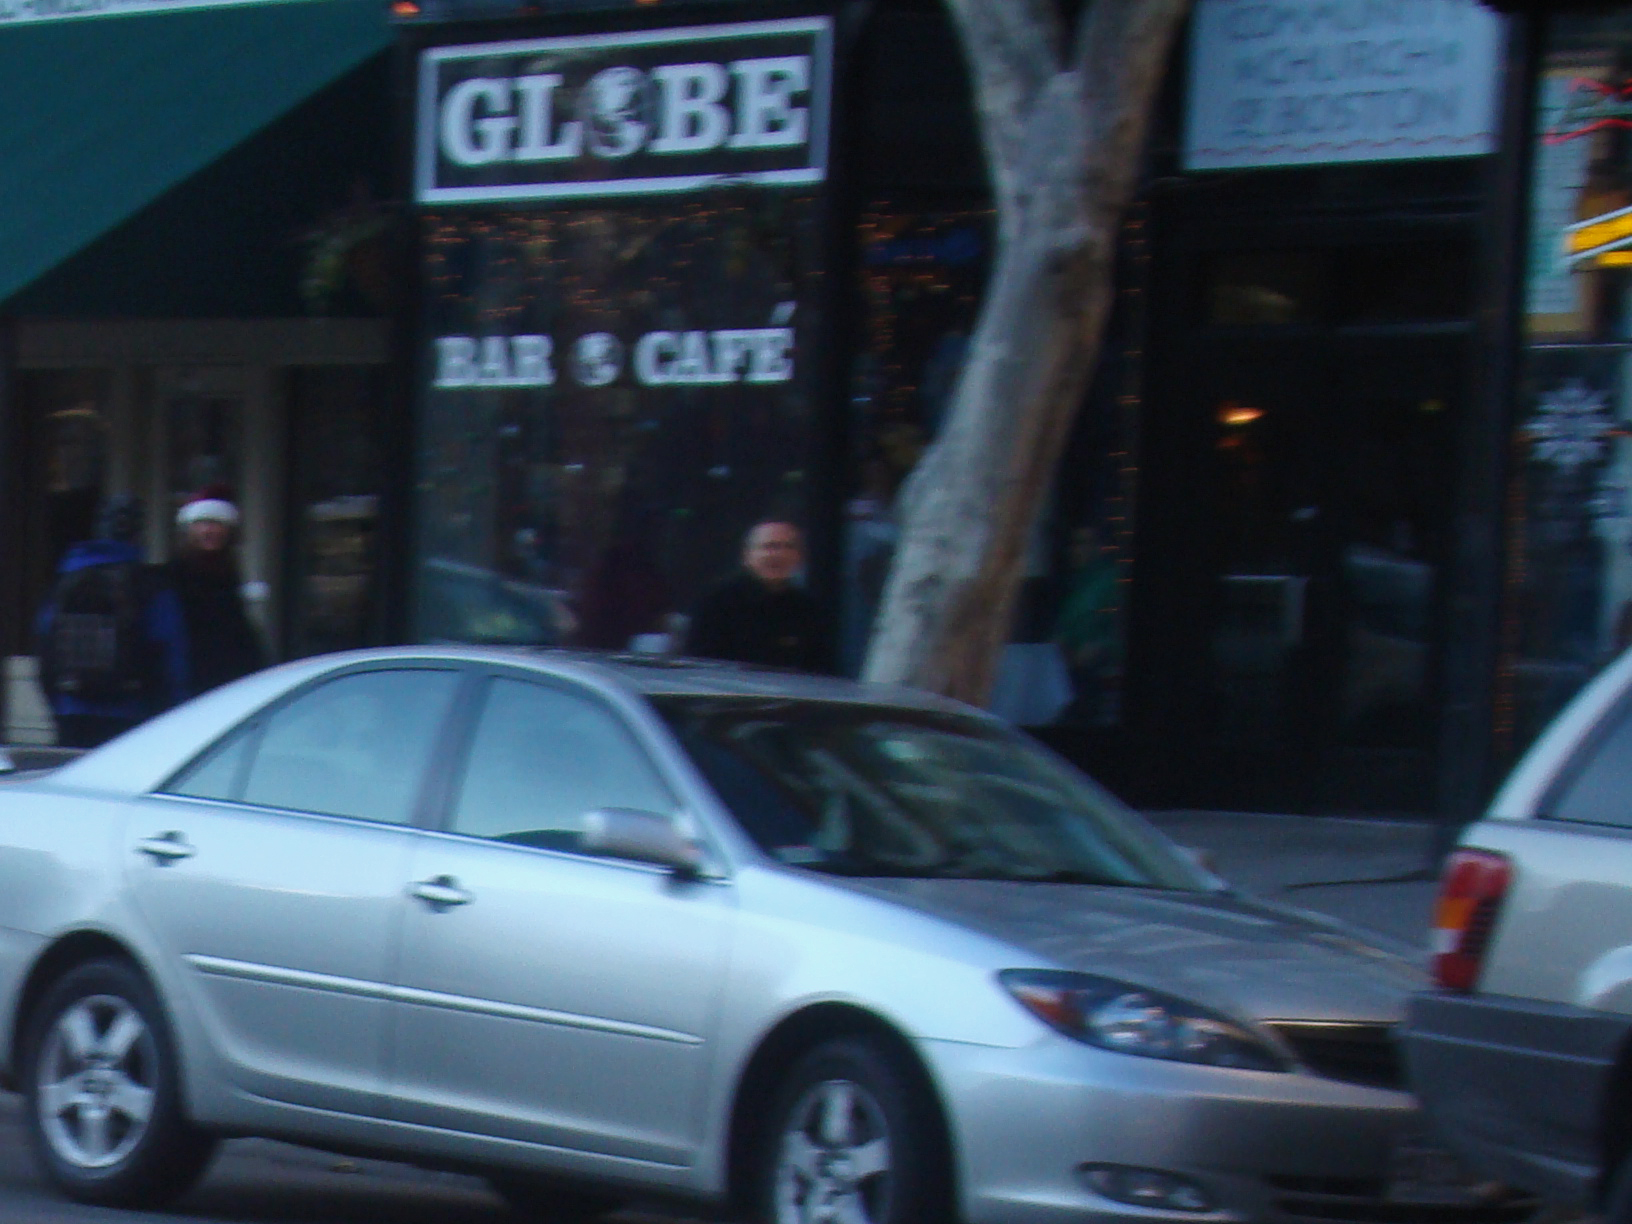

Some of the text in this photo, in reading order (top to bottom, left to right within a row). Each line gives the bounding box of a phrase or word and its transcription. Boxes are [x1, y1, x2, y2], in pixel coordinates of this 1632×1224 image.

[440, 56, 811, 167] GLOBE
[433, 301, 797, 388] BAR CAFÉ
